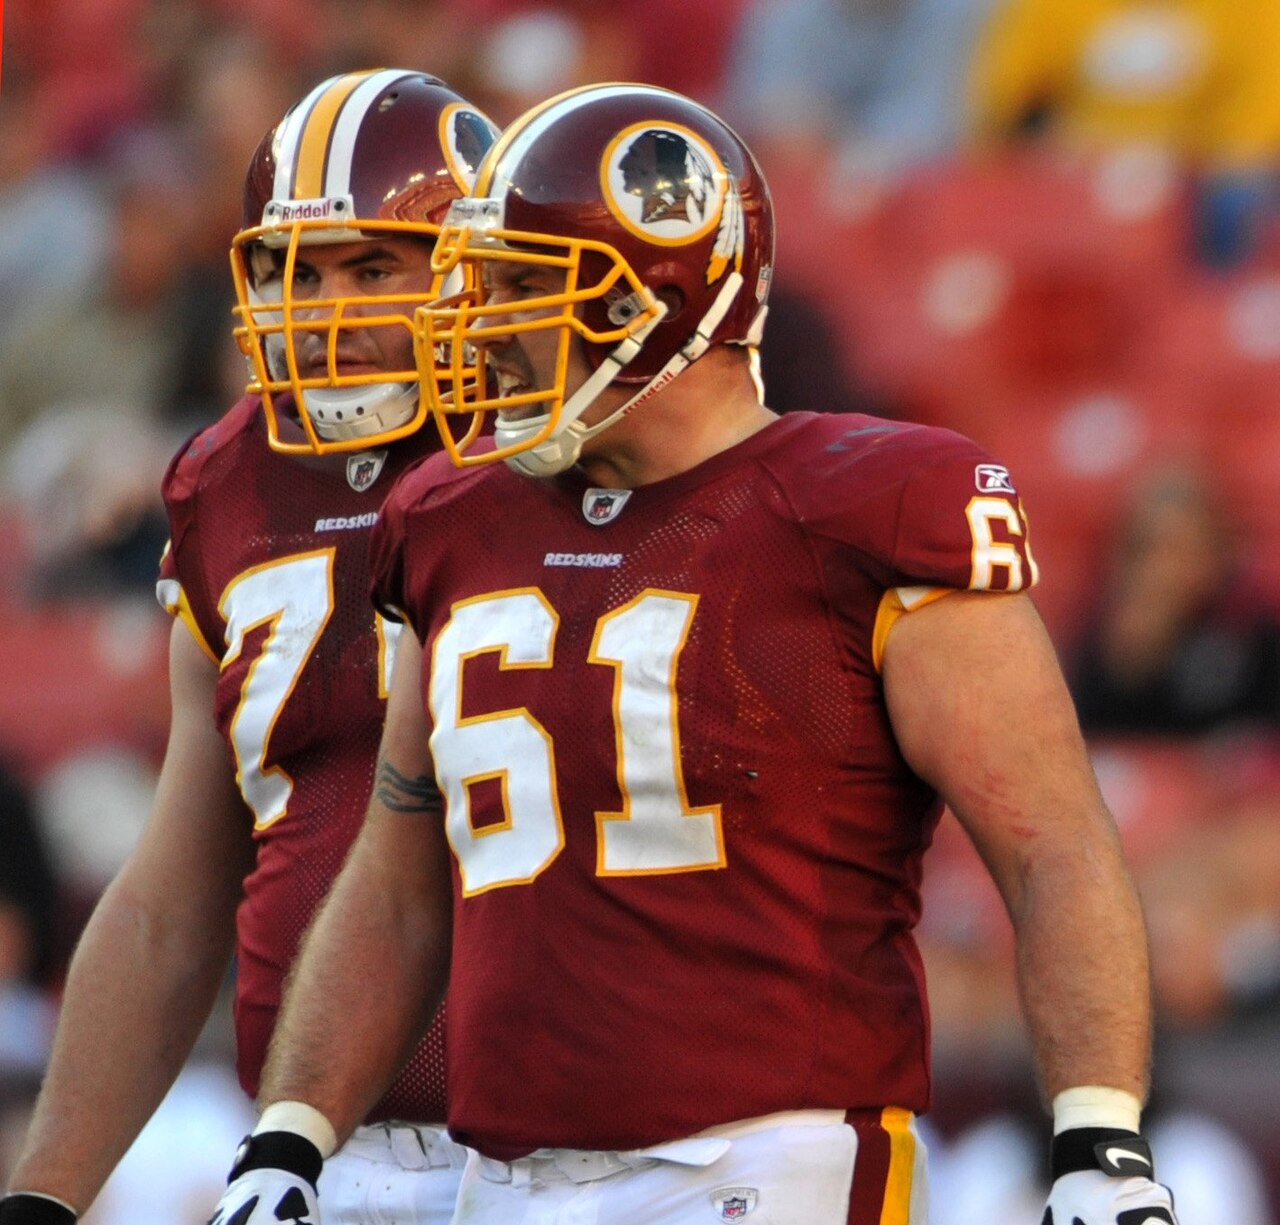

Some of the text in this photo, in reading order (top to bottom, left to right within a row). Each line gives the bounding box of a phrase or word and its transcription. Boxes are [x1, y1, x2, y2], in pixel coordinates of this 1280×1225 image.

[282, 199, 332, 221] Riddell
[543, 552, 624, 568] REDSKINS
[428, 586, 728, 899] 61
